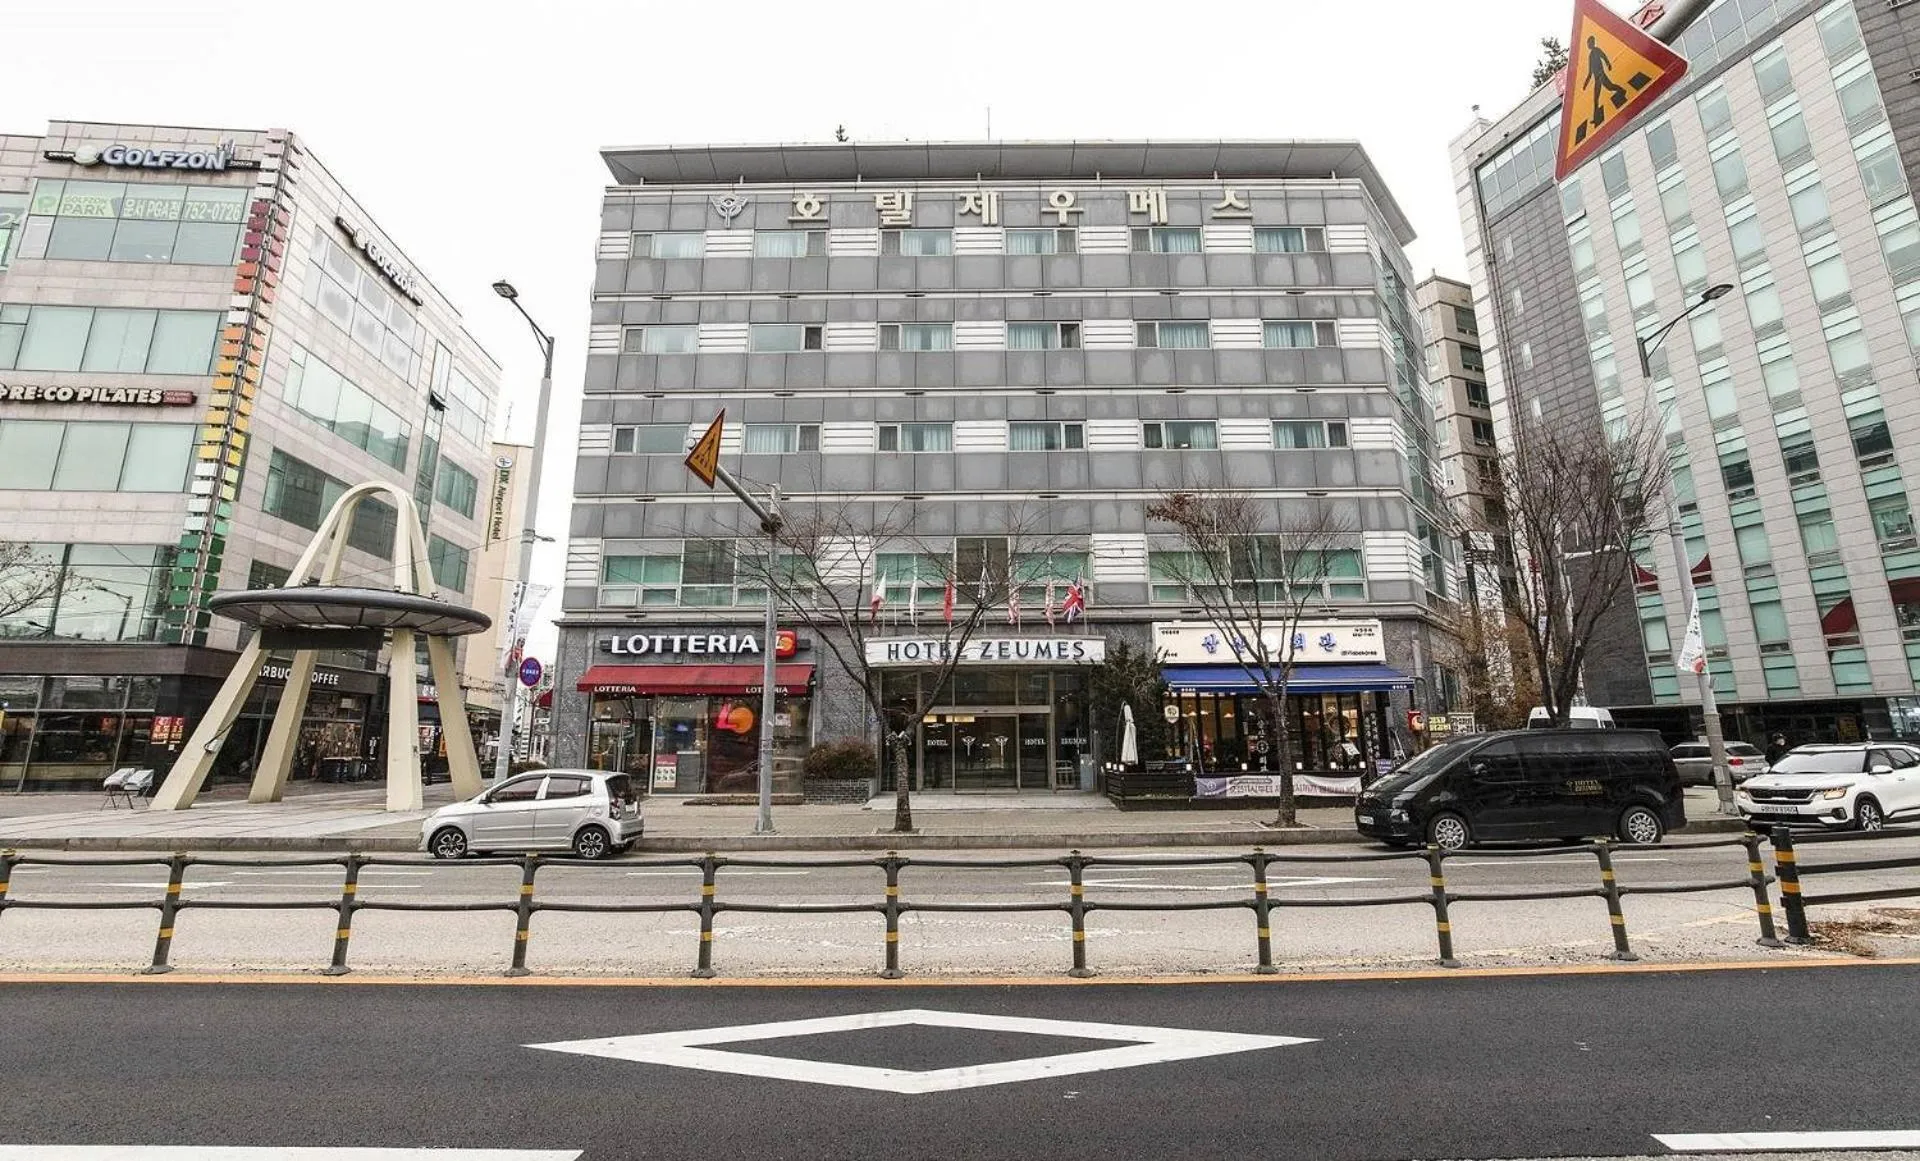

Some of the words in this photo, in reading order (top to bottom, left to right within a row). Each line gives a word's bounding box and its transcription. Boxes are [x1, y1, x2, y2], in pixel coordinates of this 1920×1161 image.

[103, 144, 226, 170] GOLFZON
[62, 203, 107, 216] PARK
[367, 240, 415, 299] GOLFZON
[77, 387, 164, 404] PILATES
[492, 516, 503, 540] Hotel
[611, 634, 760, 654] LOTTERIA
[887, 641, 969, 661] HOTEL
[980, 640, 1086, 661] ZEUMES
[311, 671, 340, 685] OFFEE
[594, 685, 637, 693] LOTTERIA
